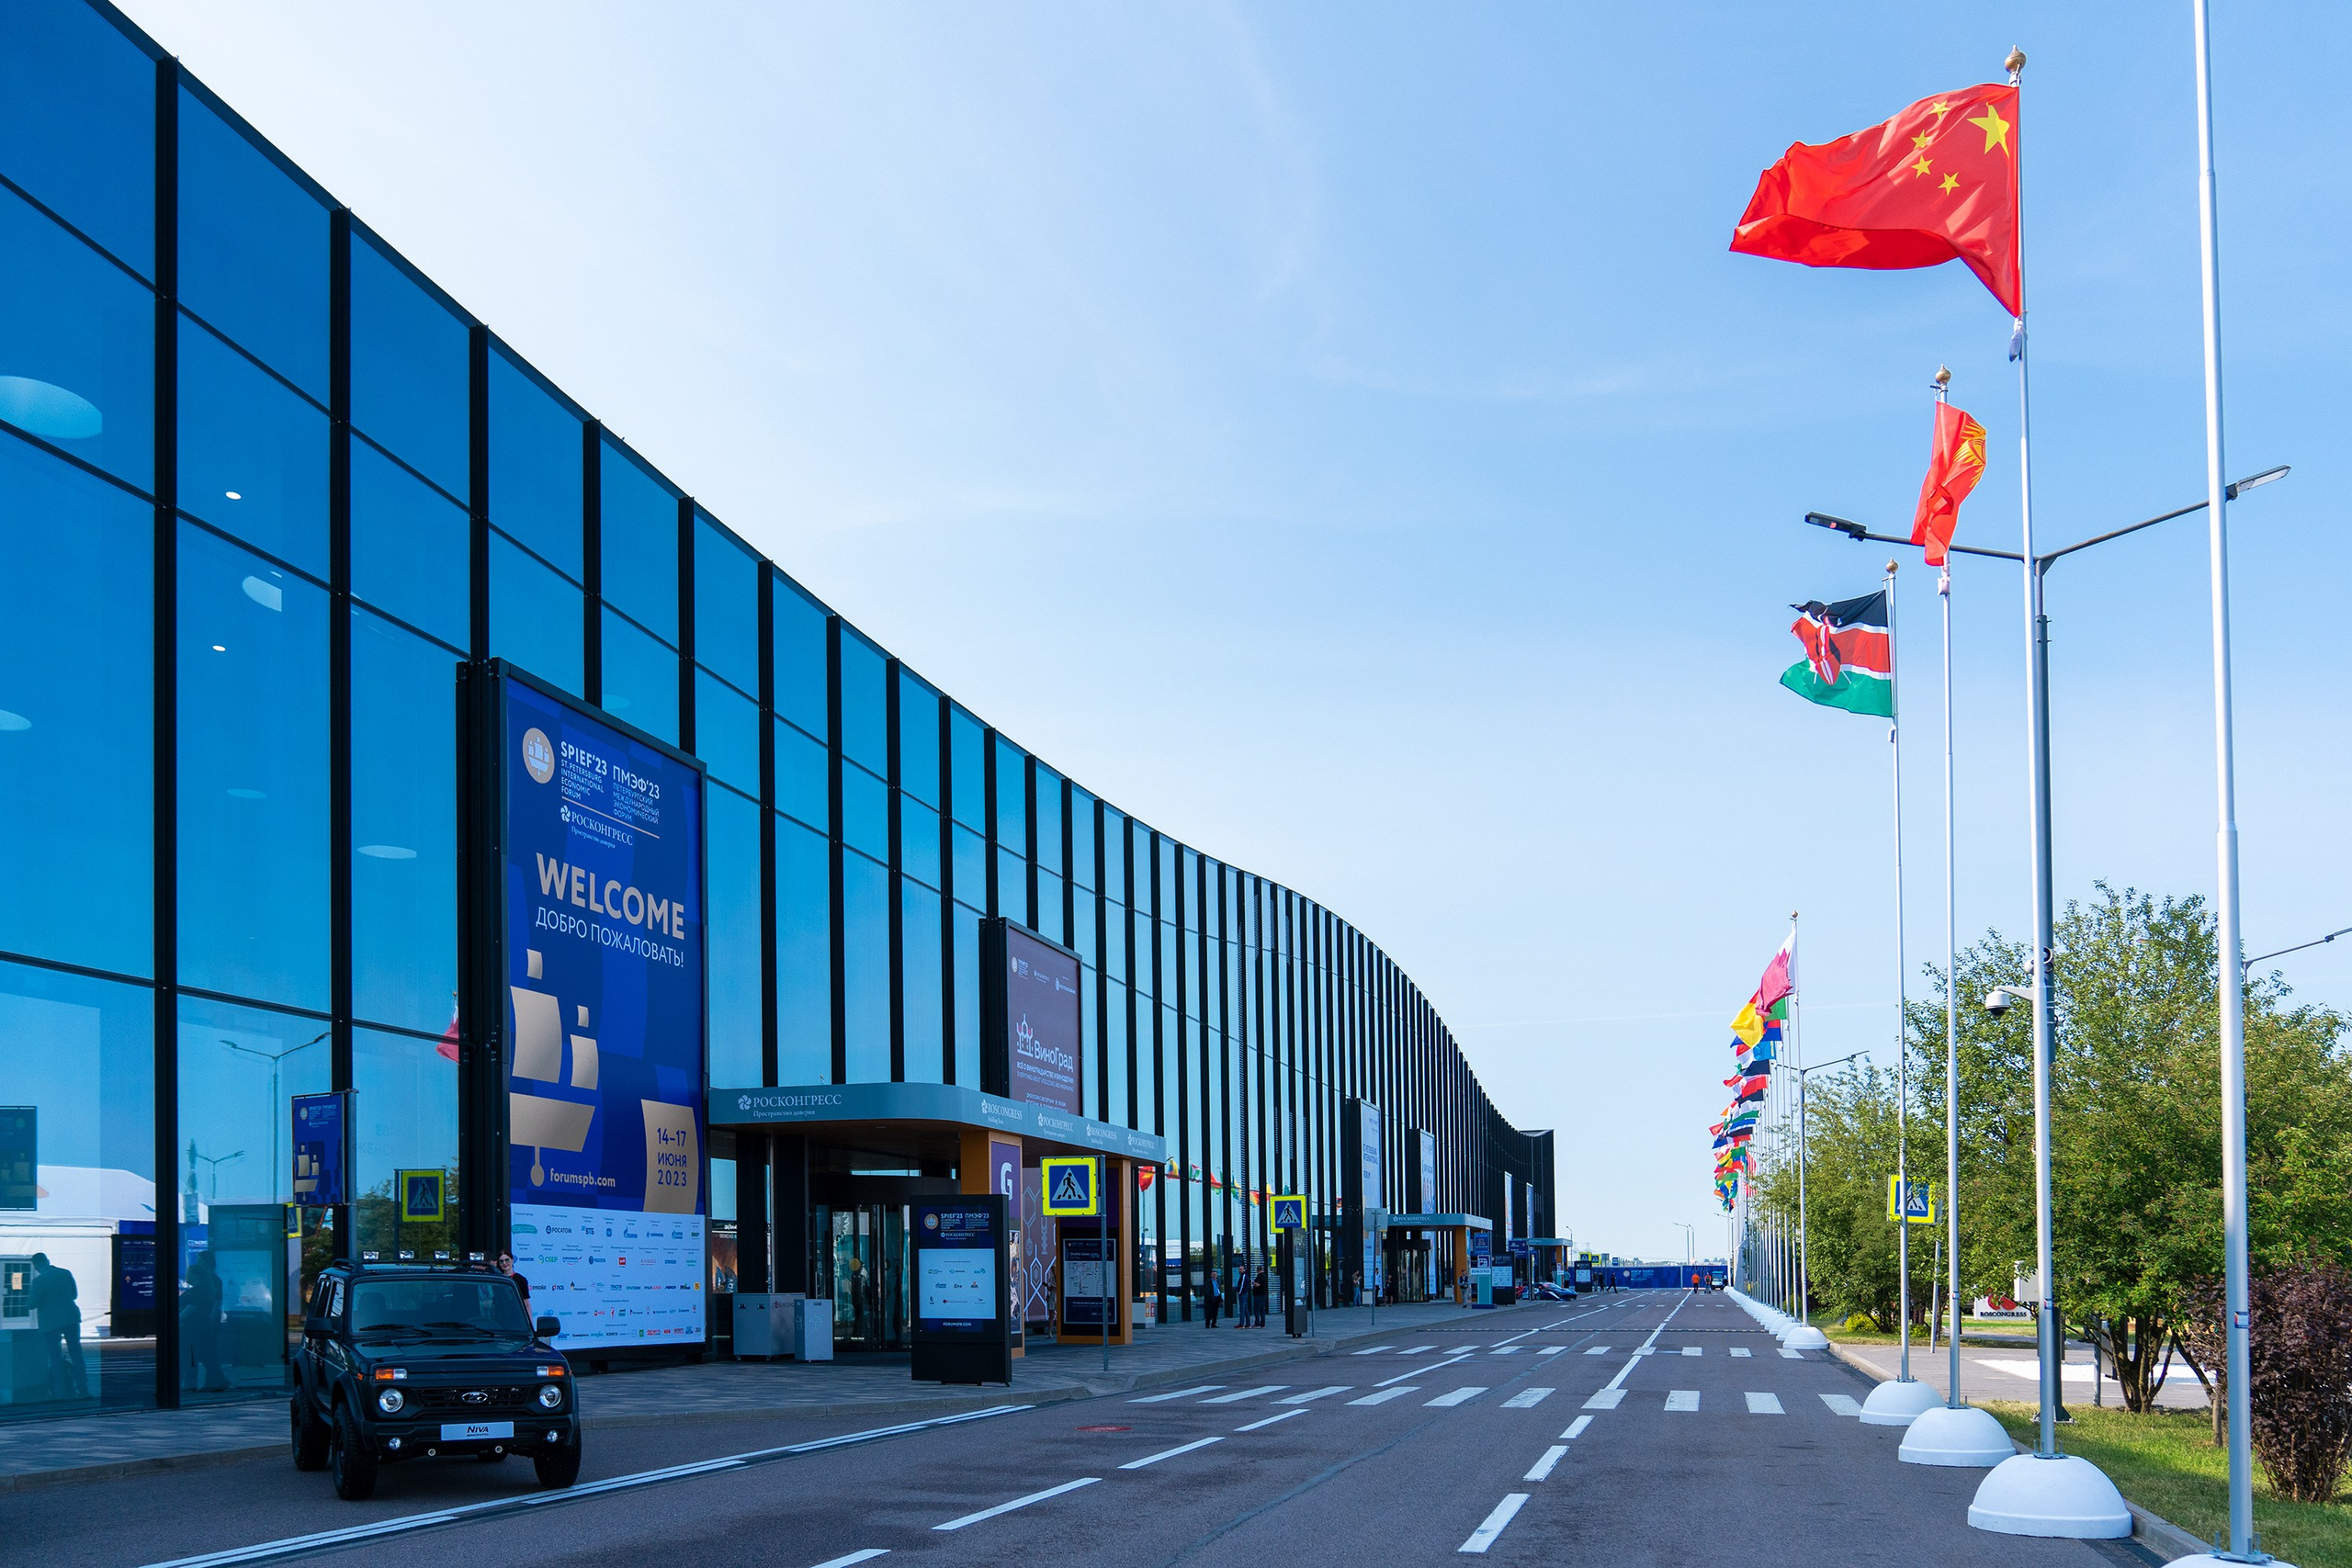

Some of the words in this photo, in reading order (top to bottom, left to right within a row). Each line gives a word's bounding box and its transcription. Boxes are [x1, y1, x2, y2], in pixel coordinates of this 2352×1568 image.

[561, 767, 604, 793] INTERNATIONAL
[570, 762, 602, 784] PETERSBURG
[561, 776, 590, 795] ECONOMIC
[561, 785, 581, 800] FORUM
[613, 808, 632, 822] ФОРУМ
[571, 811, 633, 846] РОСКОНГРЕСС
[536, 852, 684, 941] WELCOME
[536, 906, 587, 939] ДОБРО
[591, 923, 684, 967] ПОЖАЛОВАТЬ!
[1035, 1040, 1073, 1073] ВиноГрад
[753, 1094, 842, 1108] РОСКОНГРЕСС
[753, 1110, 792, 1118] Пространство
[657, 1152, 687, 1168] ИЮНЯ
[549, 1168, 616, 1188] forumspb.com
[657, 1169, 687, 1187] 2023
[1001, 1162, 1013, 1201] G
